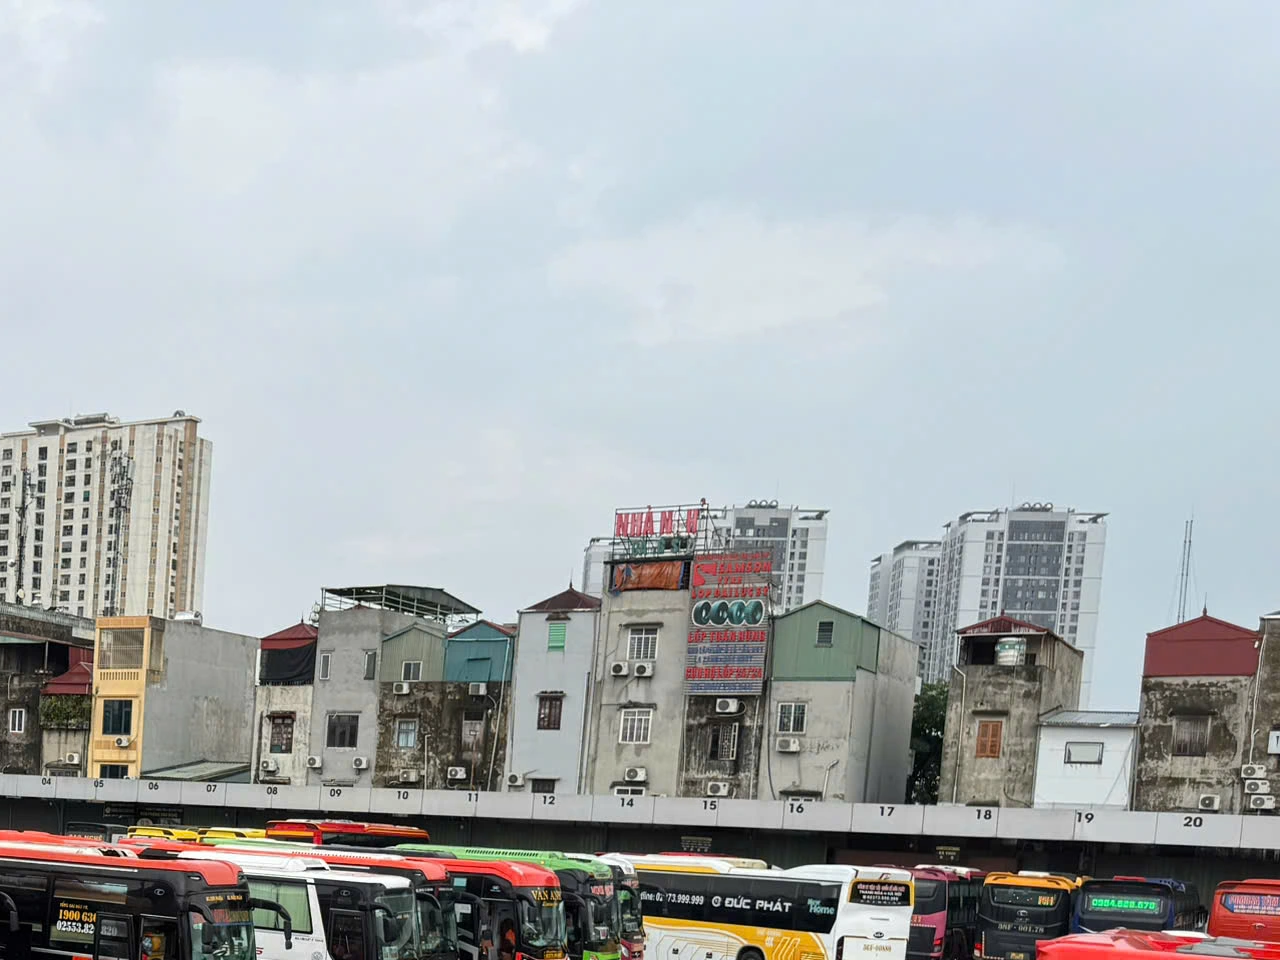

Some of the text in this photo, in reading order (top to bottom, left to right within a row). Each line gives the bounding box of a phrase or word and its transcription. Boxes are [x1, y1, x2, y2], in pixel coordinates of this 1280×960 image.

[94, 780, 104, 788] 05
[148, 782, 159, 790] 06
[206, 784, 217, 793] 07
[266, 786, 278, 795] 08
[329, 788, 342, 798] 09
[397, 790, 409, 800] 10
[468, 793, 479, 802] 11
[542, 795, 555, 805] 12
[620, 797, 634, 807] 14
[702, 800, 717, 810] 15
[789, 803, 805, 813] 16
[879, 806, 895, 817] 17
[975, 809, 992, 820] 18
[1076, 811, 1095, 823] 19
[1183, 816, 1204, 828] 20
[725, 896, 792, 912] ĐỨC PHÁT
[59, 909, 80, 920] 1900
